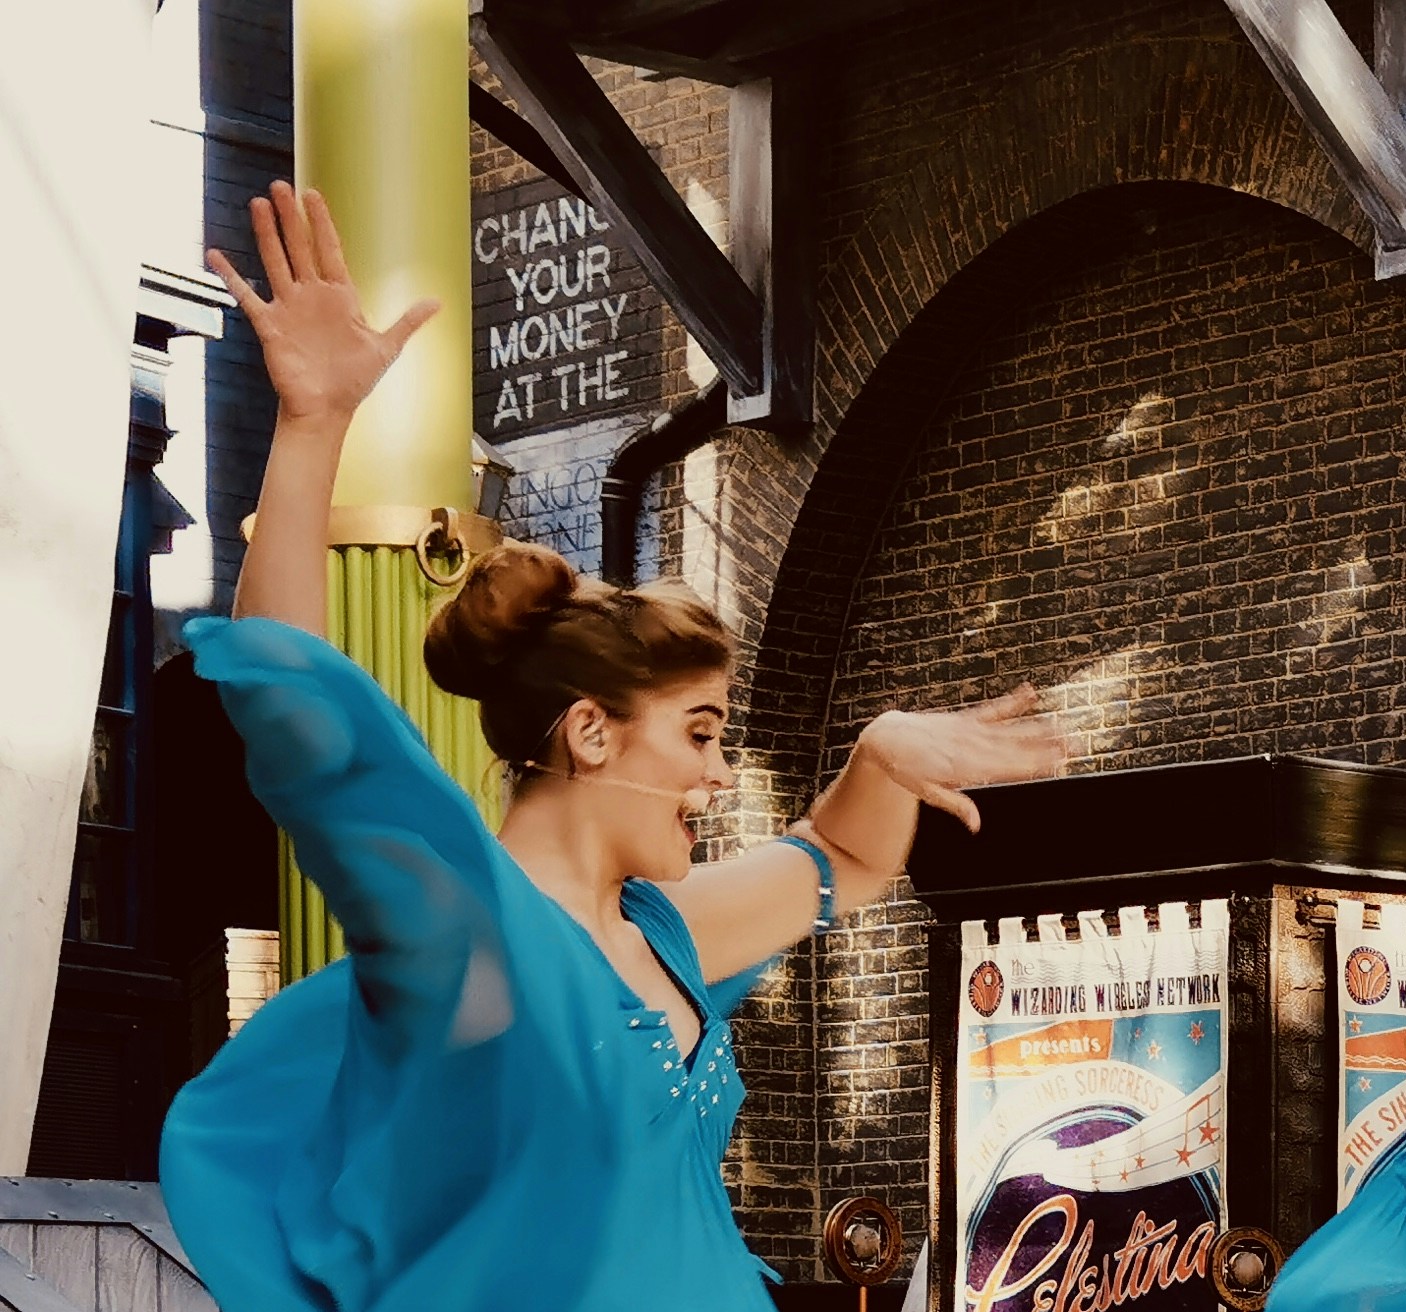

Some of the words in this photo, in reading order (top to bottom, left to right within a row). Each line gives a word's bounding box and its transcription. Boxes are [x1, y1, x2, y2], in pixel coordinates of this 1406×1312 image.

[506, 245, 611, 311] YOUR
[489, 293, 628, 370] MONEY
[493, 372, 543, 429] AT
[551, 350, 629, 412] THE
[1011, 984, 1086, 1016] WIZARDING
[1157, 973, 1221, 1006] NETWORK
[1020, 1035, 1101, 1059] presents
[1074, 1067, 1164, 1112] SORCERESS
[1344, 1120, 1383, 1166] THE
